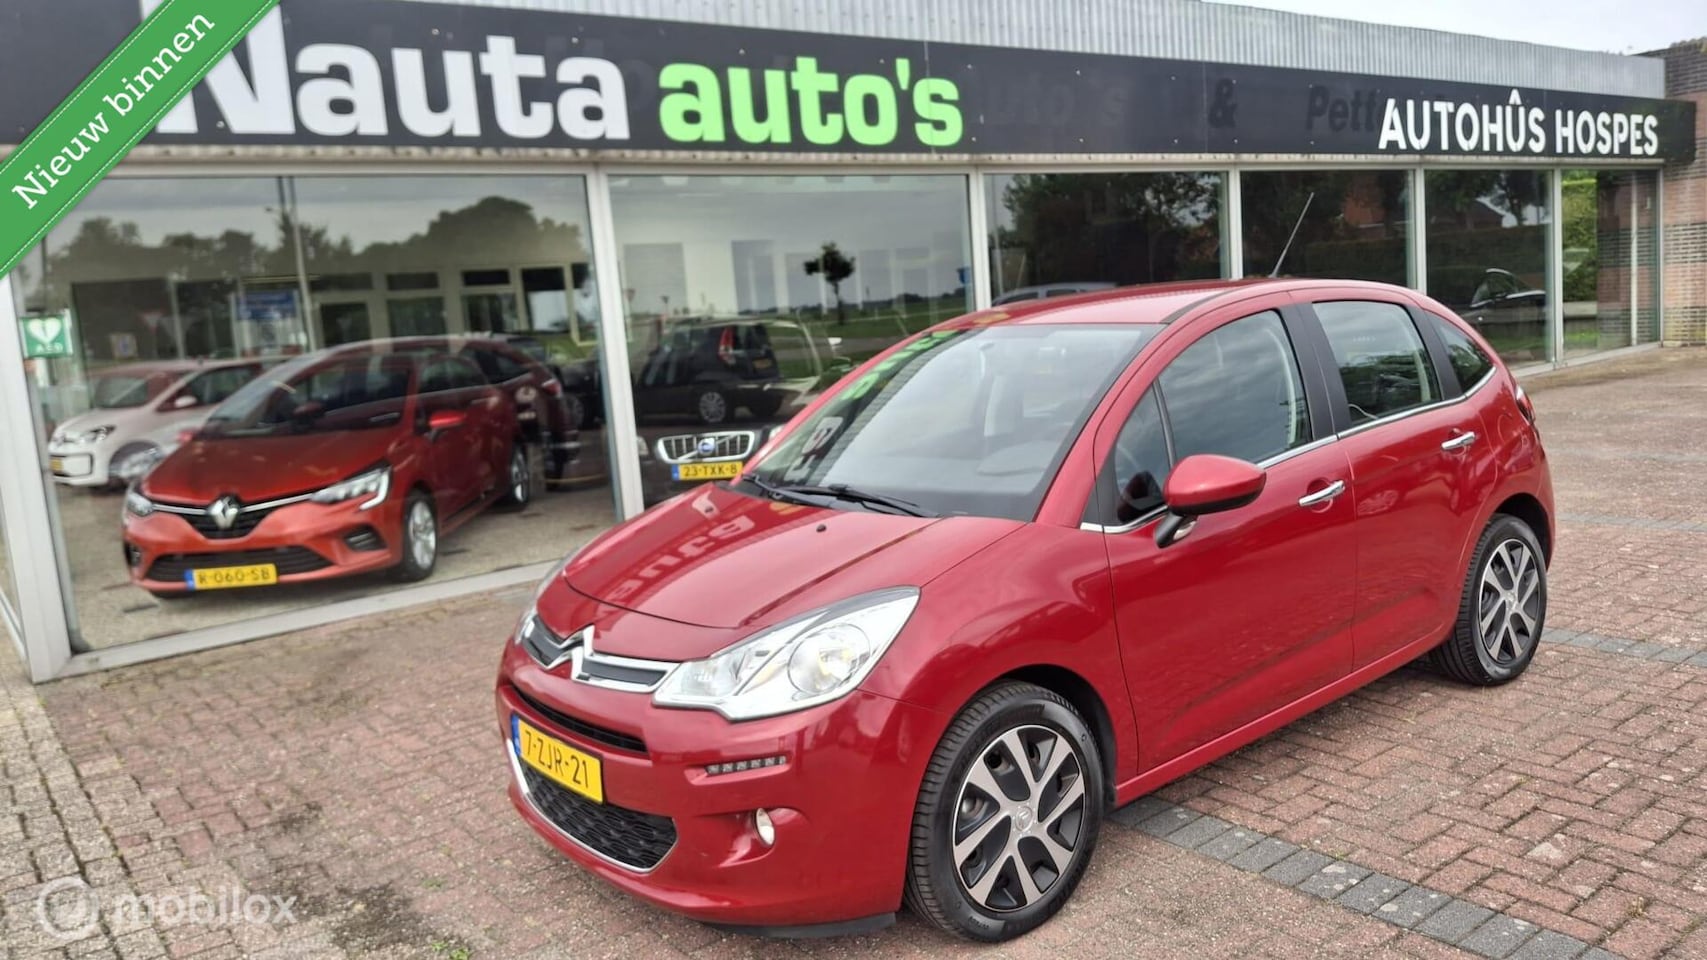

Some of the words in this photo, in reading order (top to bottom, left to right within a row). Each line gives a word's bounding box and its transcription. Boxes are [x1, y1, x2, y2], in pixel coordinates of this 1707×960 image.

[139, 0, 631, 141] Nauta
[658, 56, 964, 147] auto's
[1378, 88, 1546, 153] AUTOHÛS
[1555, 109, 1658, 155] HOSPES
[524, 729, 589, 789] 7-ZJR-21
